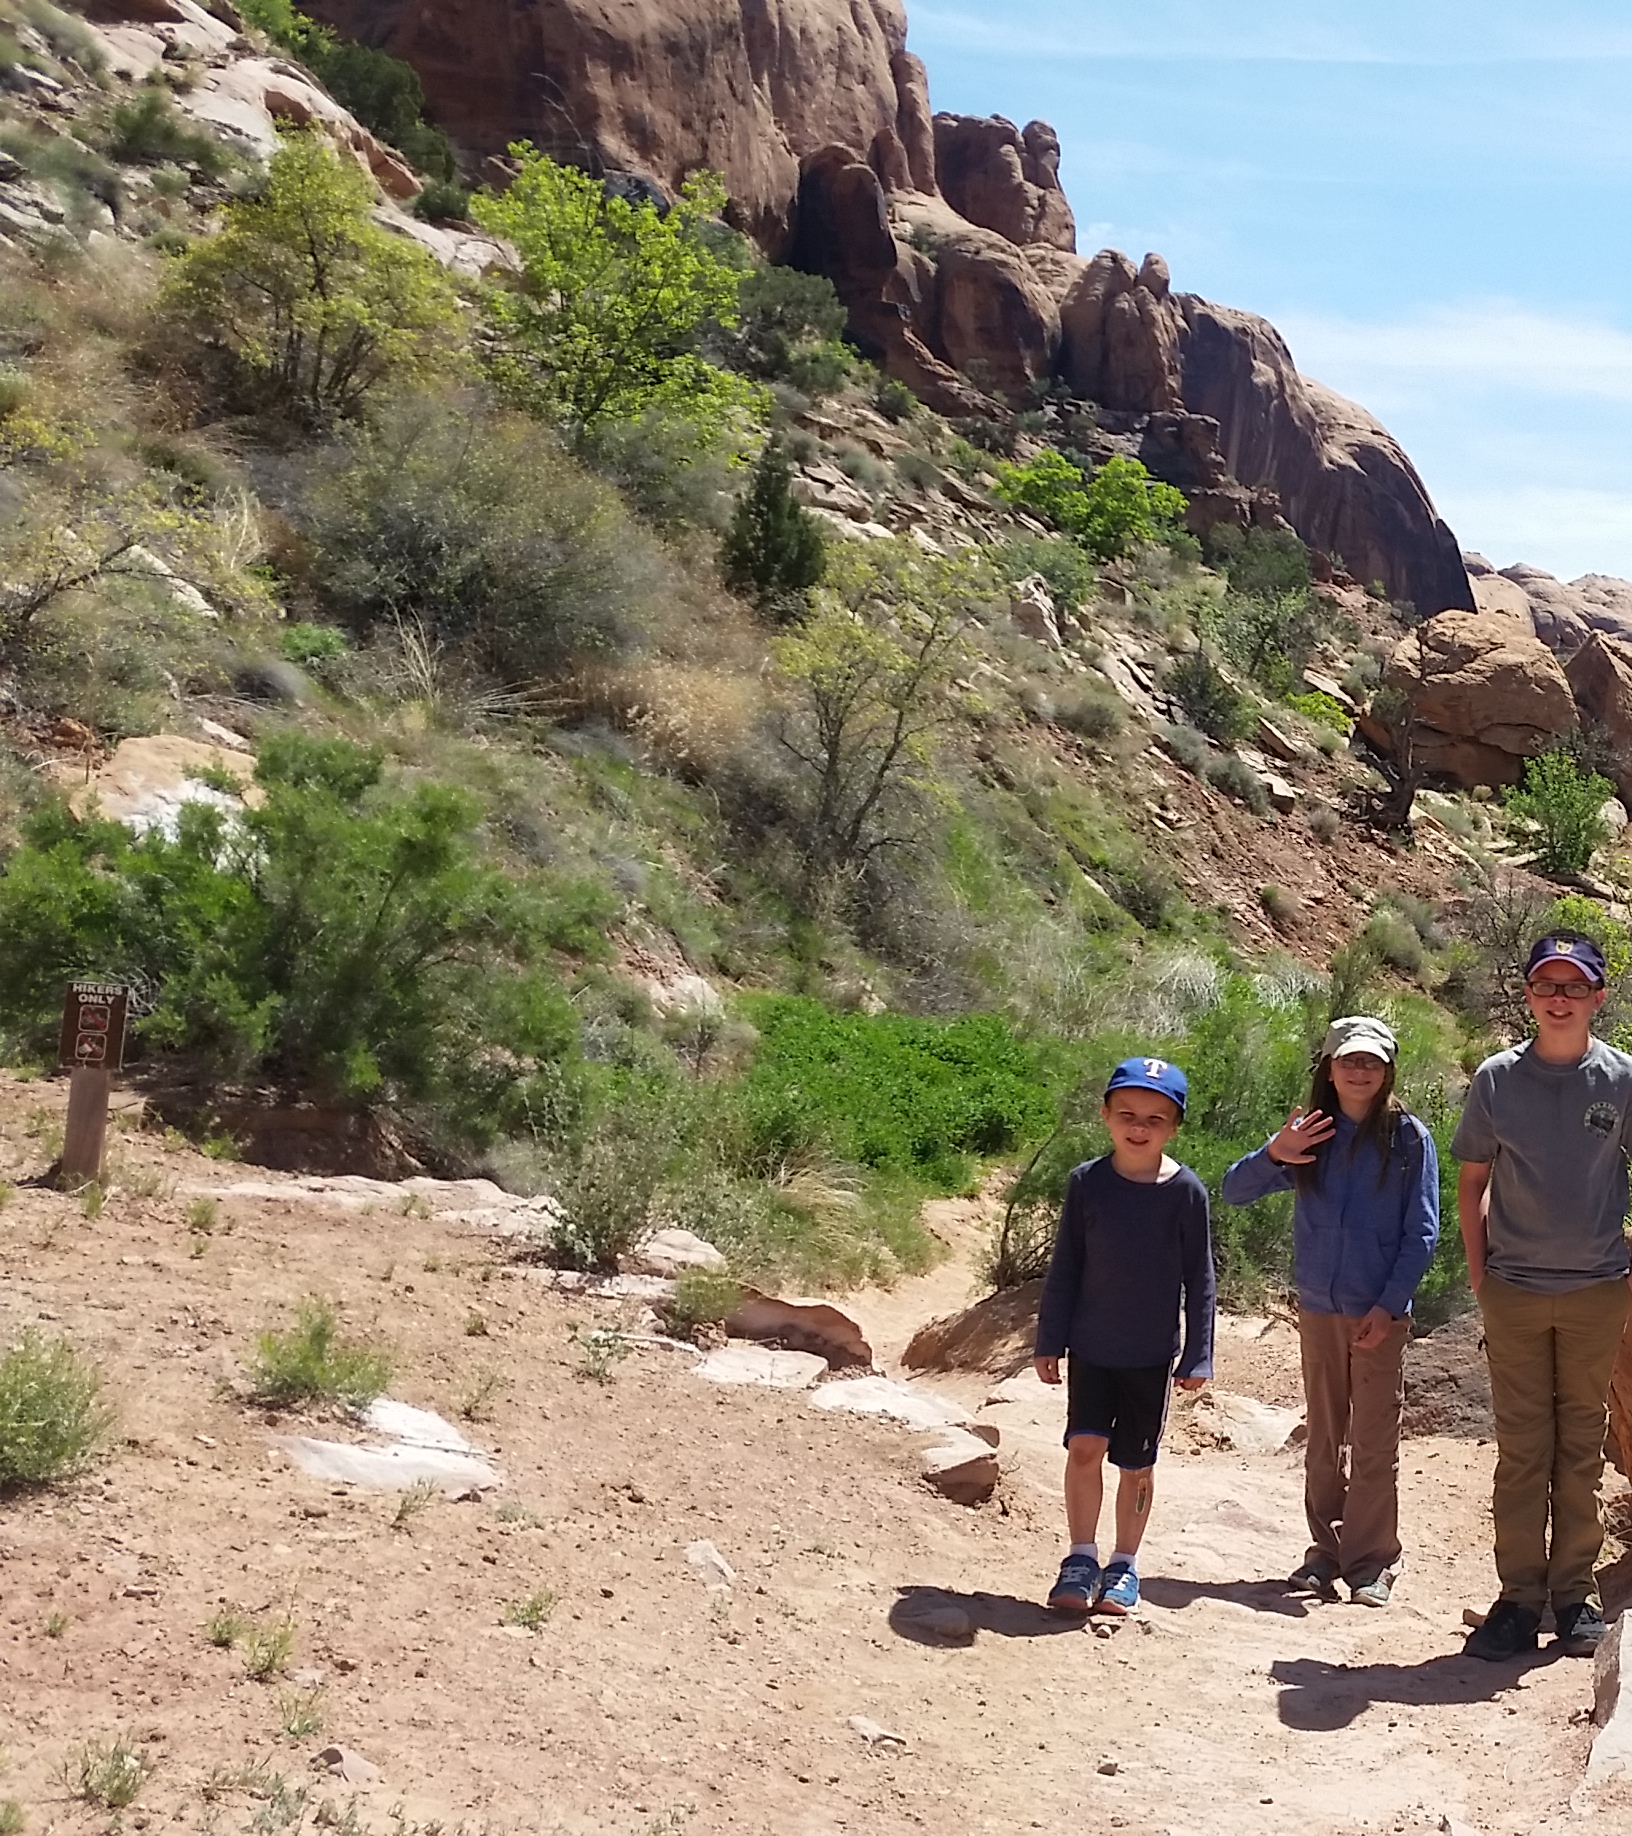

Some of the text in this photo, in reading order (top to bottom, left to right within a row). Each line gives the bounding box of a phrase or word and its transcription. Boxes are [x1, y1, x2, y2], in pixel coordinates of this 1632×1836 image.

[72, 983, 123, 996] HIKERS
[78, 994, 115, 1005] ONLY
[1143, 1058, 1168, 1079] T
